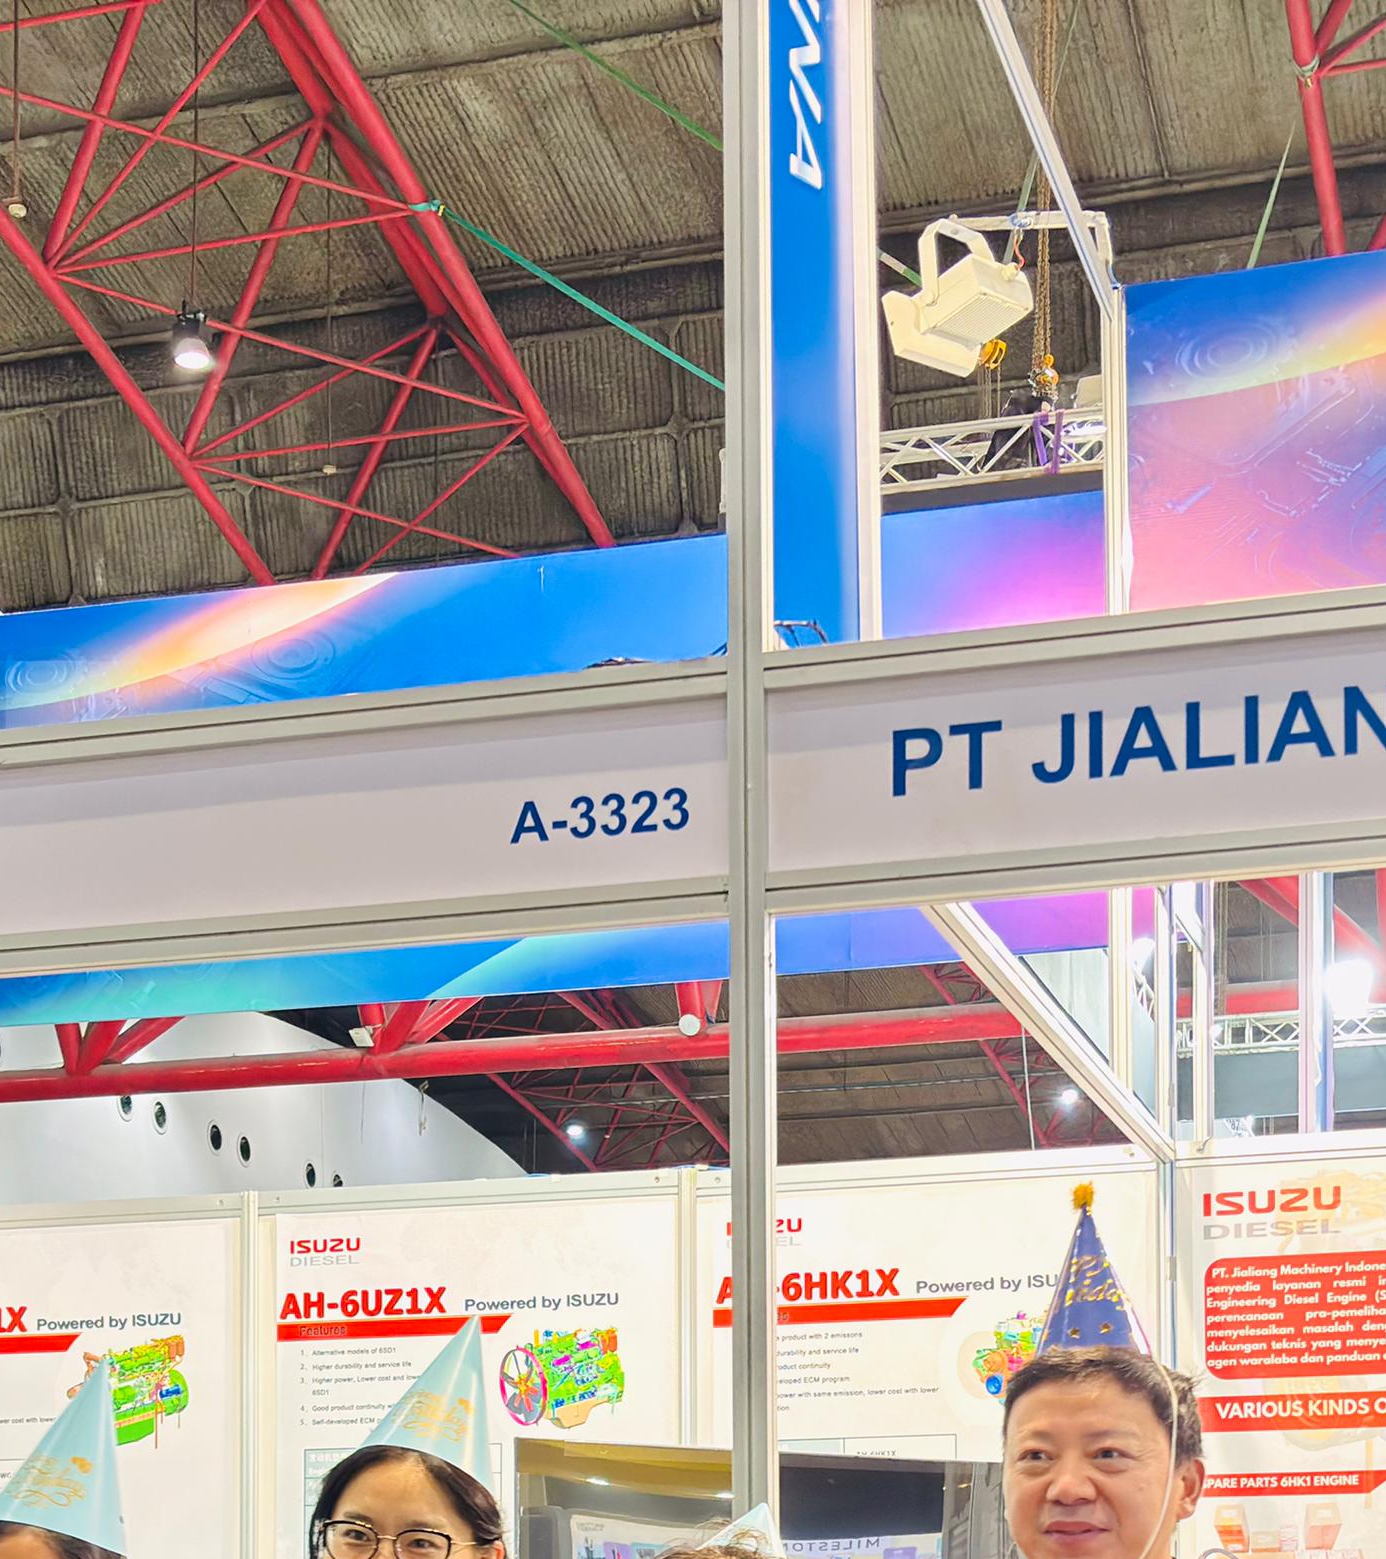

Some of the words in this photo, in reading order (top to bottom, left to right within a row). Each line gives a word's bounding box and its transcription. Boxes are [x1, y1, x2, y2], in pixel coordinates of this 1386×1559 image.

[892, 719, 1003, 797] PT
[510, 787, 690, 844] A-3323
[1202, 1185, 1341, 1217] ISUZU
[1202, 1218, 1341, 1241] DIESEL
[290, 1237, 361, 1254] ISUZU
[290, 1255, 360, 1268] DIESEL
[1211, 1266, 1229, 1278] PT.
[1231, 1266, 1278, 1278] Jialiang
[1280, 1264, 1343, 1275] Machinery
[716, 1267, 900, 1305] A6HK1X
[916, 1278, 994, 1294] Powered
[999, 1276, 1022, 1293] by
[1206, 1280, 1261, 1296] penyedia
[1272, 1277, 1321, 1293] layanan
[1333, 1275, 1366, 1287] resmi
[280, 1286, 447, 1321] AH-6UZ1X
[464, 1296, 537, 1312] Powered
[541, 1295, 562, 1311] by
[566, 1292, 619, 1308] ISUZU
[1206, 1295, 1277, 1311] Engineering
[1284, 1293, 1319, 1305] Diesel
[1326, 1291, 1367, 1307] Engine
[36, 1315, 104, 1332] Powered
[108, 1314, 127, 1330] by
[132, 1312, 182, 1327] ISUZU
[1206, 1312, 1284, 1326] perencanaan
[299, 1325, 347, 1336] Features
[1206, 1324, 1295, 1341] menyelesaikan
[1303, 1321, 1354, 1334] masalah
[1206, 1339, 1267, 1355] dukungan
[1271, 1337, 1307, 1350] teknis
[1311, 1339, 1342, 1351] yang
[1206, 1357, 1237, 1370] agen
[1239, 1353, 1298, 1365] waralaba
[1300, 1351, 1324, 1363] dan
[1326, 1349, 1381, 1365] panduan
[1215, 1400, 1304, 1419] VARIOUS
[1309, 1398, 1369, 1416] KINDS
[1239, 1475, 1279, 1488] PARTS
[1279, 1474, 1313, 1488] 6HK1
[1313, 1474, 1360, 1487] ENGINE
